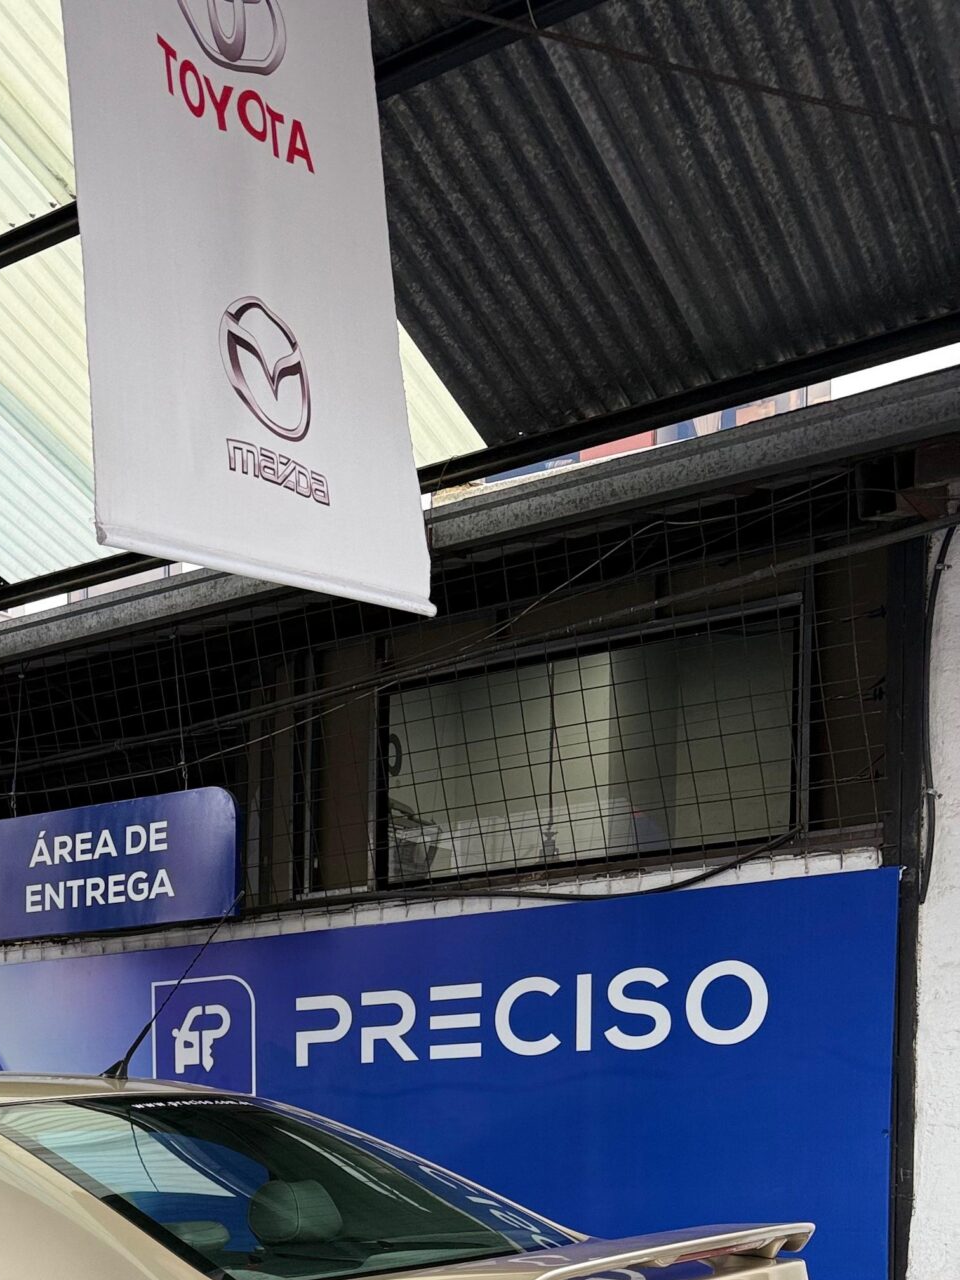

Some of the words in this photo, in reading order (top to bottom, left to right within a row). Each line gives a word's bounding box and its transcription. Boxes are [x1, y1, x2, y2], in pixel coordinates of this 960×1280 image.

[157, 34, 315, 174] TOYOTA
[29, 829, 118, 868] ÁREA
[126, 820, 168, 855] DE
[25, 869, 175, 913] ENTREGA
[295, 960, 769, 1067] PRECISO
